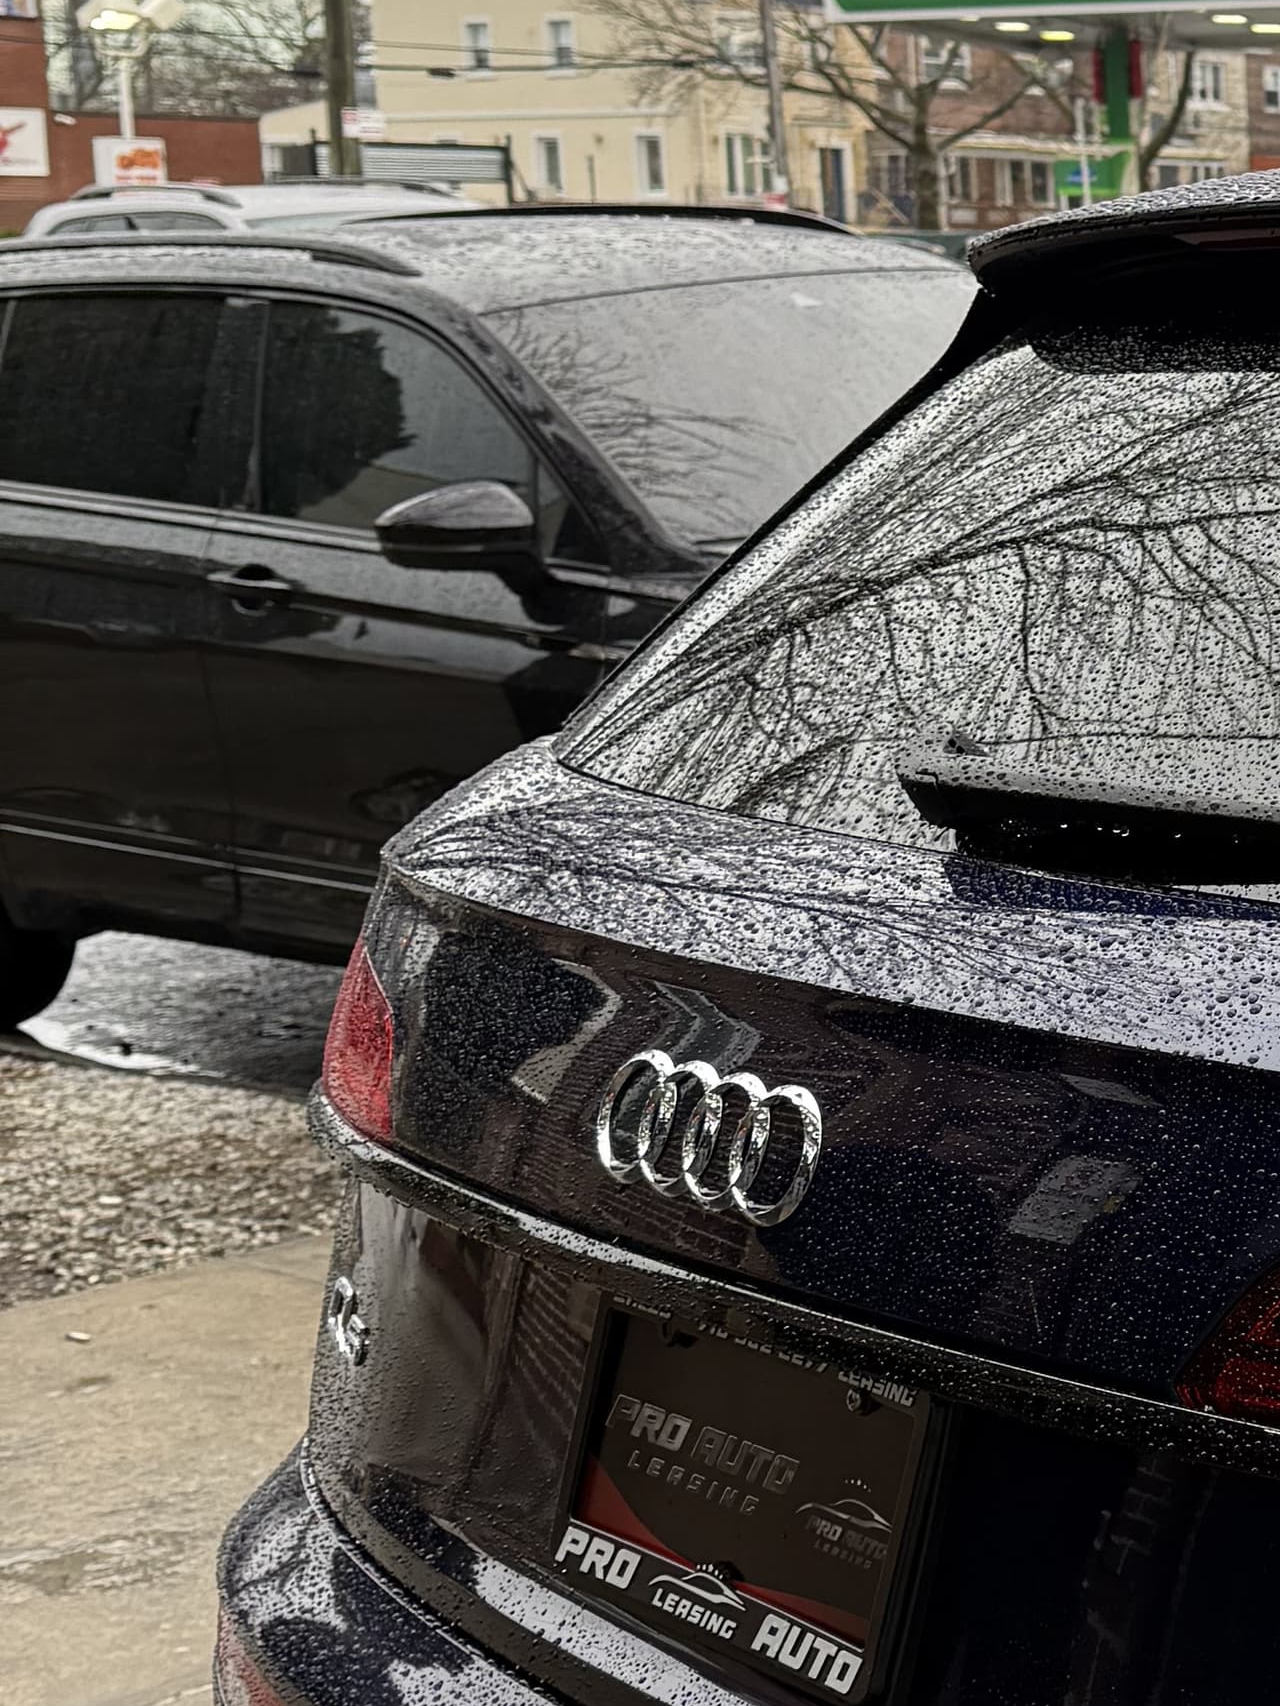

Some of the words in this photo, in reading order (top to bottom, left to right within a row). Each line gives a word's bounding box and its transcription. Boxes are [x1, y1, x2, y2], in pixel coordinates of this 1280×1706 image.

[605, 1394, 693, 1452] PRO
[690, 1425, 800, 1493] AUTO
[627, 1449, 760, 1516] LEASING
[805, 1515, 843, 1542] PRO
[554, 1525, 642, 1589] PRO
[651, 1587, 737, 1639] LEASING
[751, 1612, 863, 1695] AUTO
